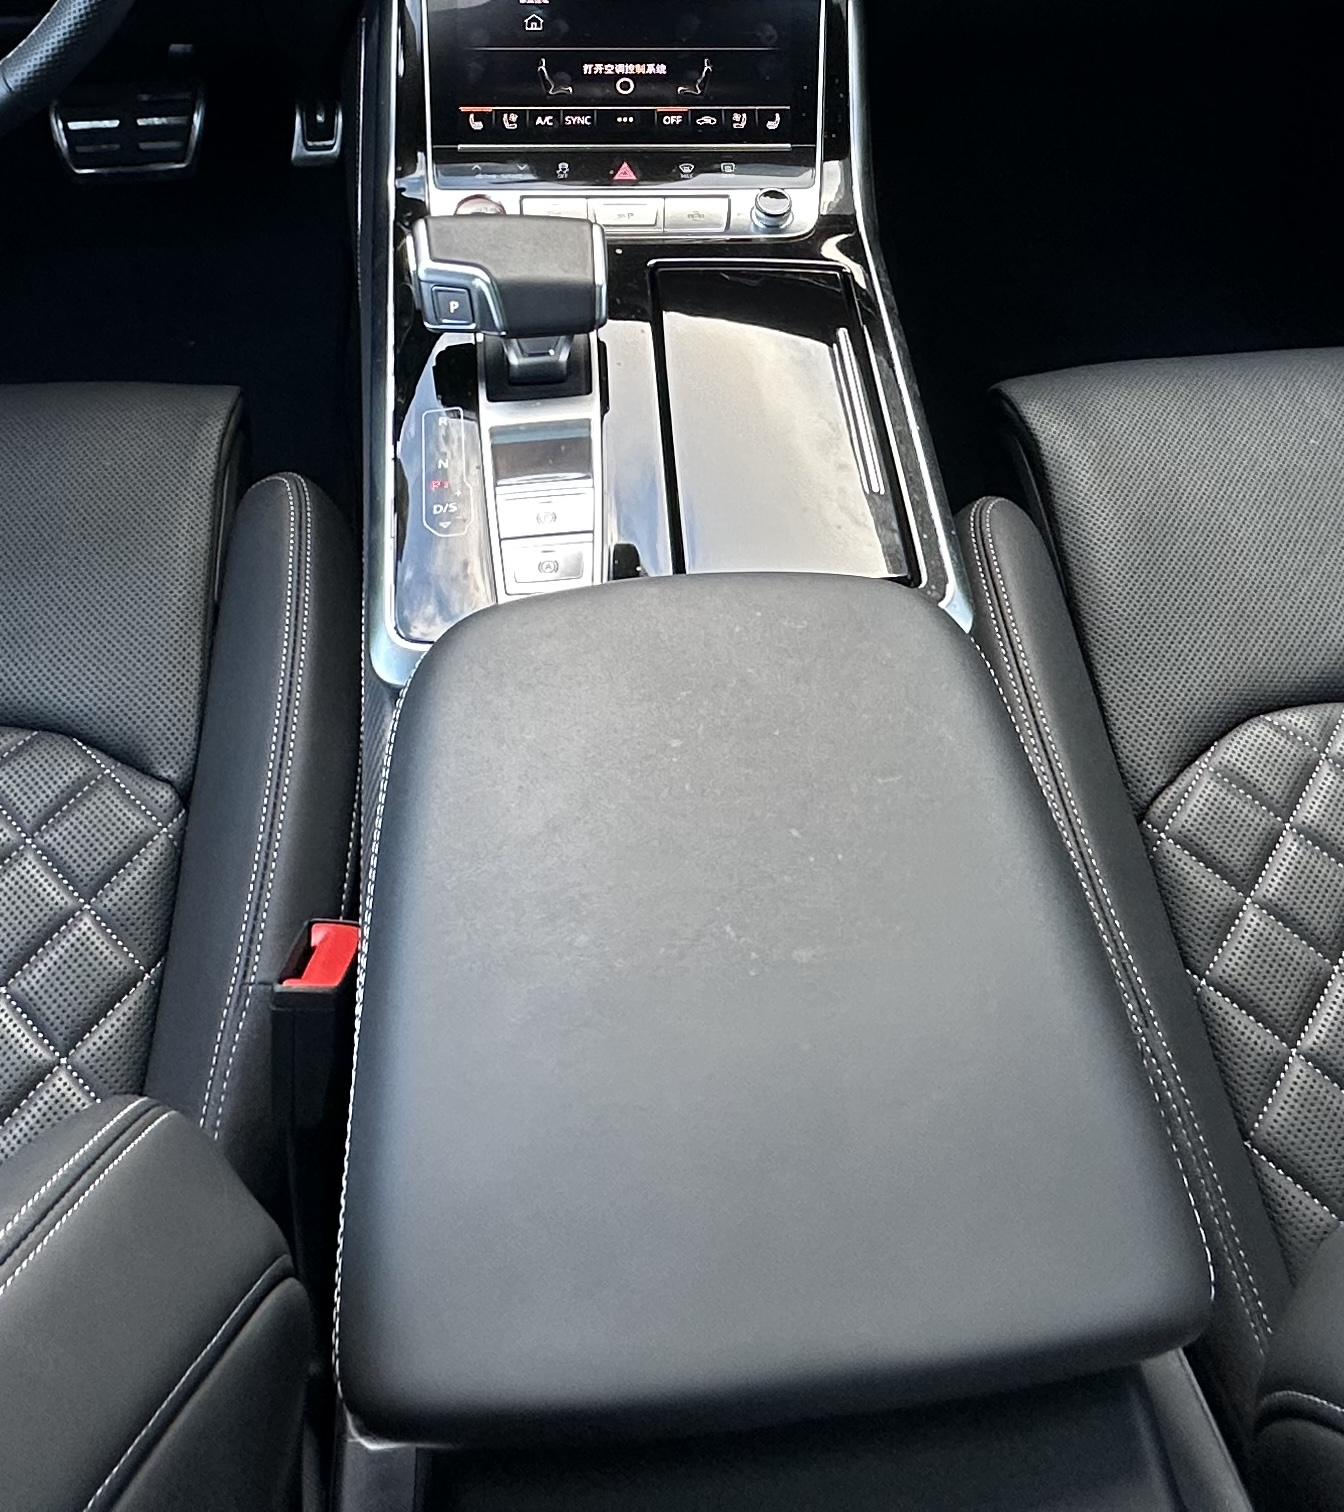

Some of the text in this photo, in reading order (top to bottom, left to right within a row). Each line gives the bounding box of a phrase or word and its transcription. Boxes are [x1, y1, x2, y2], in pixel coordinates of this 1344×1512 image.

[582, 63, 668, 76] 打开空调控制系统
[535, 115, 554, 127] A/C
[564, 115, 593, 127] SYNC
[662, 115, 683, 126] OFF
[448, 300, 460, 314] P
[438, 416, 448, 426] R
[437, 458, 449, 469] N
[432, 502, 458, 515] D/S
